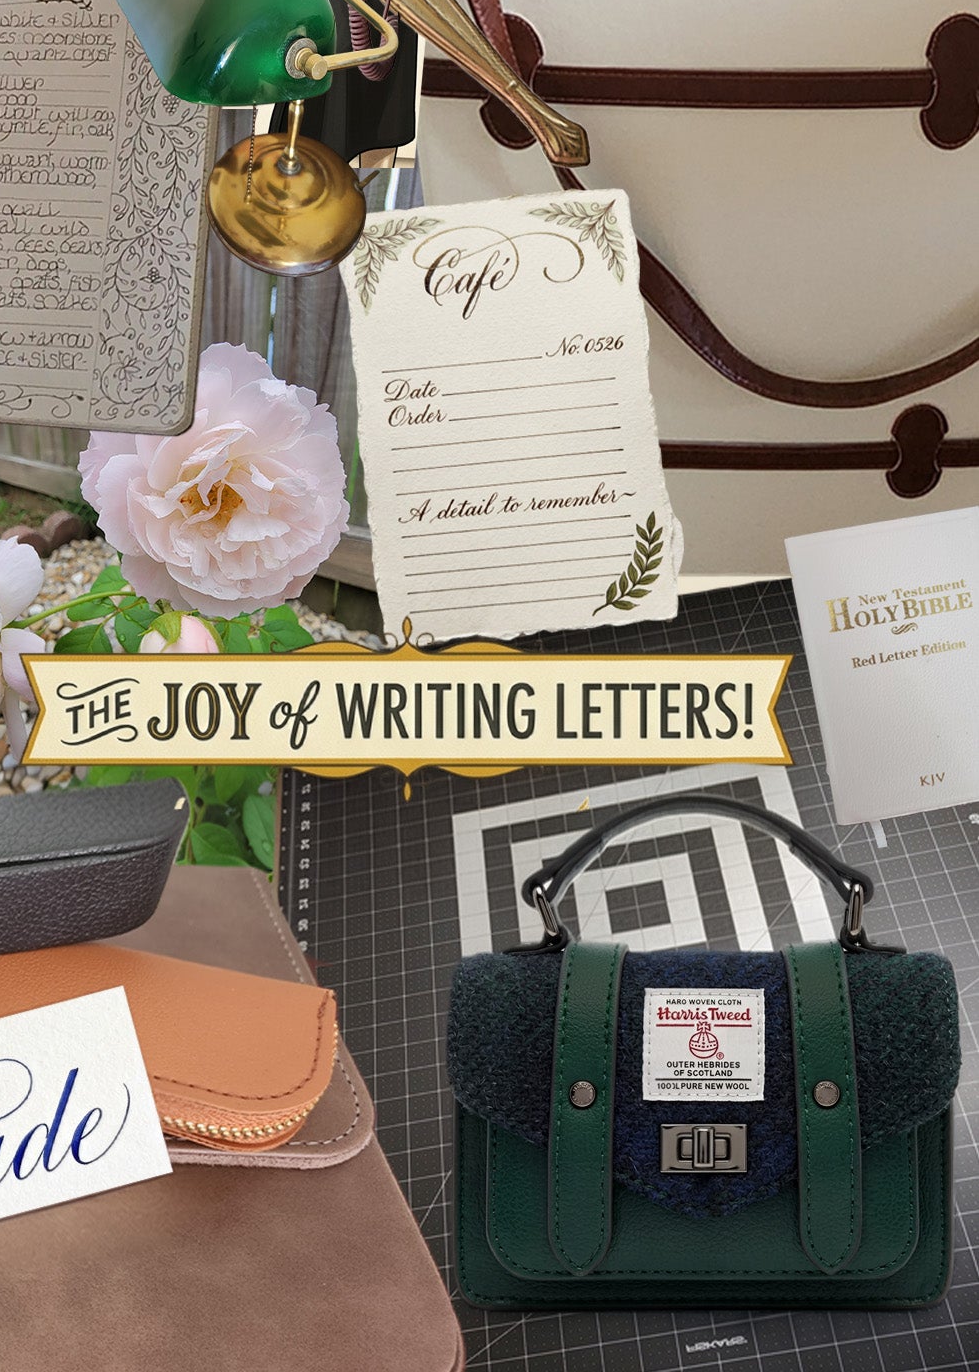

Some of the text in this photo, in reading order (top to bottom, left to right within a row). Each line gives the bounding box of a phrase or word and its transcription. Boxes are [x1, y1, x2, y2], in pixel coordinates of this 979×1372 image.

[545, 334, 625, 358] No. 0526
[384, 378, 440, 403] Date
[388, 404, 448, 428] Order
[398, 498, 432, 524] A
[429, 492, 498, 524] detail
[497, 495, 522, 514] to
[858, 578, 967, 607] New Testament
[825, 591, 973, 634] HOLY BIBLE
[851, 639, 967, 669] Red Letter Edition
[65, 679, 754, 751] THE JOY of WRITING LETTERS!
[919, 771, 945, 787] KJV
[657, 1007, 752, 1021] Harris Tweed
[666, 1061, 741, 1069] OUTER HEBRIDES
[673, 1069, 733, 1077] OF SCOTLAND
[680, 1082, 703, 1090] PURE
[704, 1082, 724, 1090] NEW
[725, 1082, 750, 1090] WOOL
